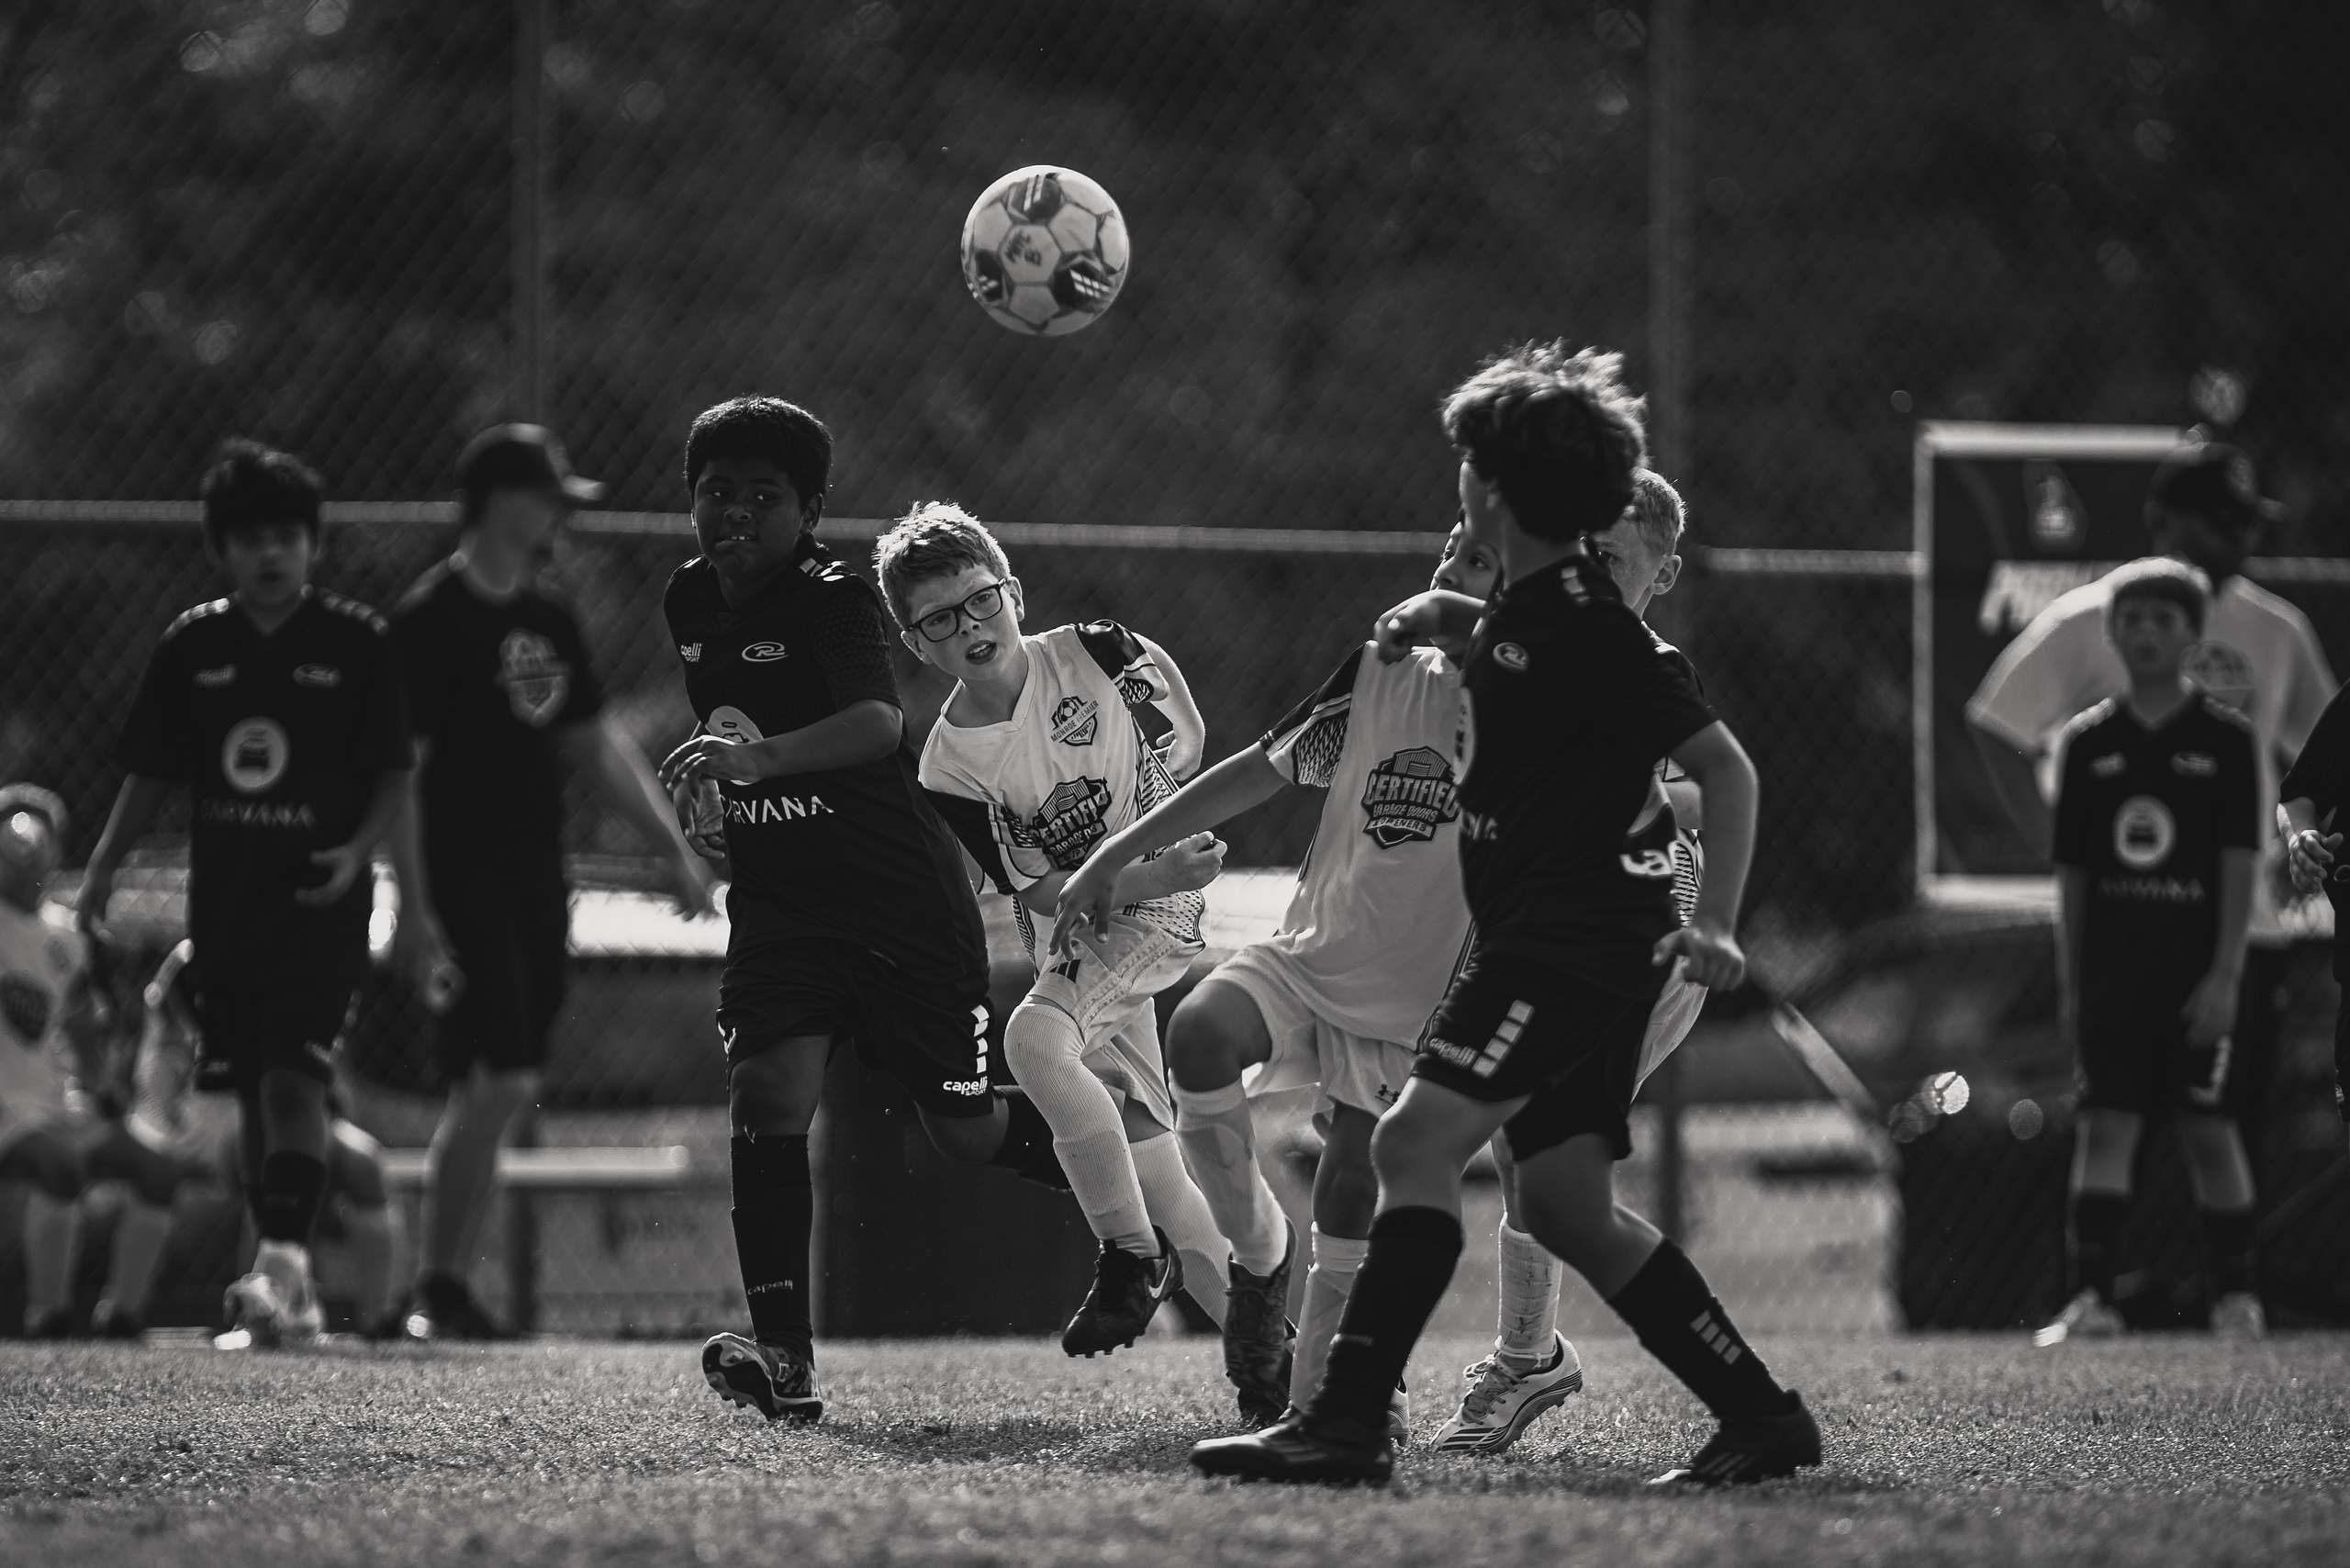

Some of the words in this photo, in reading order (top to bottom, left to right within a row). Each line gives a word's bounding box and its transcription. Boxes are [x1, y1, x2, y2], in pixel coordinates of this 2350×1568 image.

[1050, 720, 1077, 742] MONROE
[721, 795, 834, 824] RVANA
[1027, 789, 1110, 846] ERTIFI
[1406, 805, 1438, 823] DOORS
[943, 1075, 989, 1094] capelli
